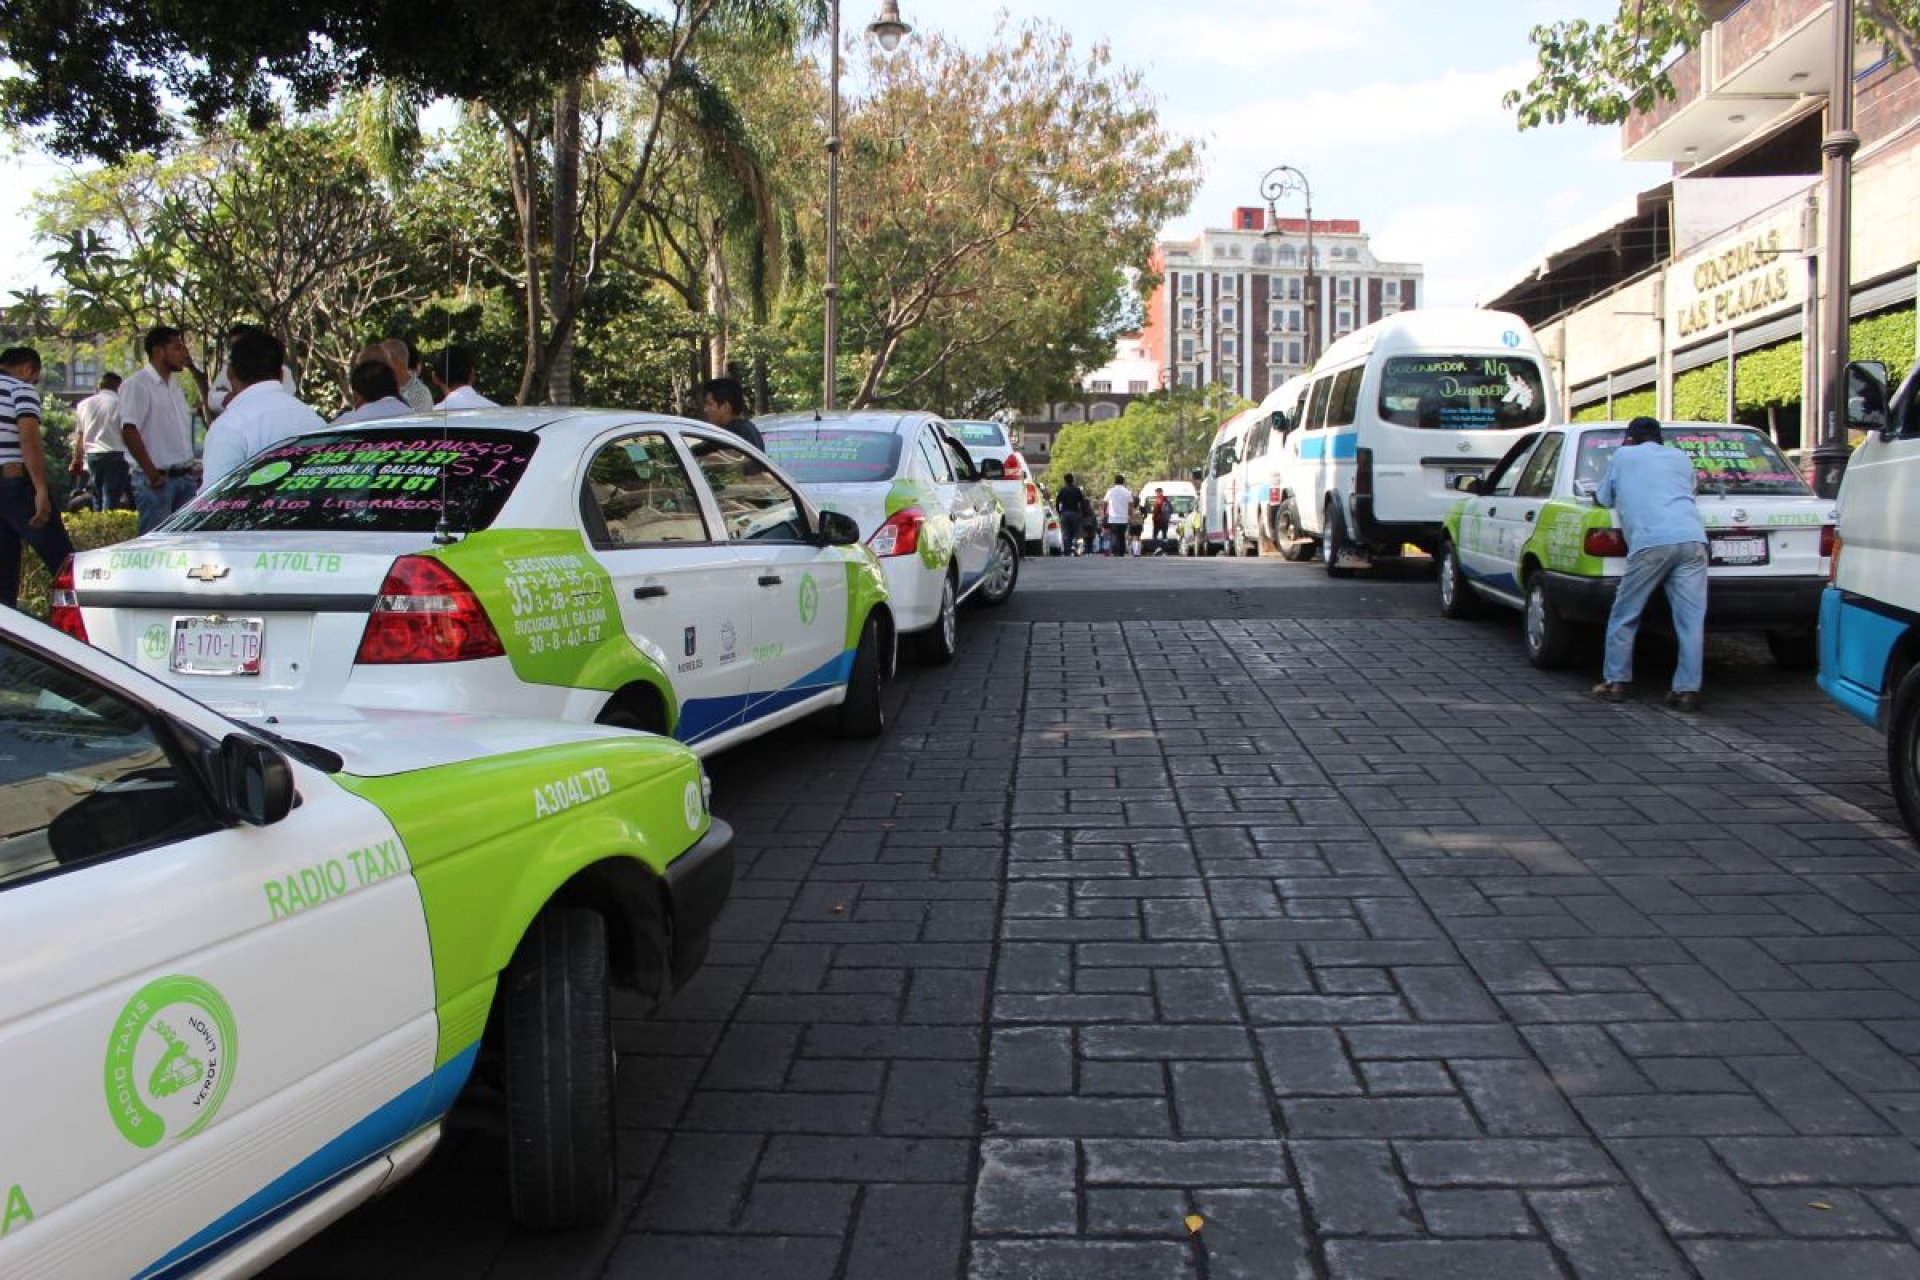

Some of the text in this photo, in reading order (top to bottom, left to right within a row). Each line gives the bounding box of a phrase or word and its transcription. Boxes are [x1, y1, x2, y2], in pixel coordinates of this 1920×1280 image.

[1693, 229, 1779, 293] CINEMAS
[1677, 267, 1788, 337] LAS PLAZAS
[109, 550, 342, 573] CUAUTLA A170LTB
[505, 575, 534, 617] 35
[178, 632, 259, 658] A-170-LTB
[534, 767, 612, 819] A304LTB
[264, 839, 401, 921] RADIO TAXI
[114, 999, 150, 1127] RADIO TAXIS
[192, 1058, 217, 1106] VERDE
